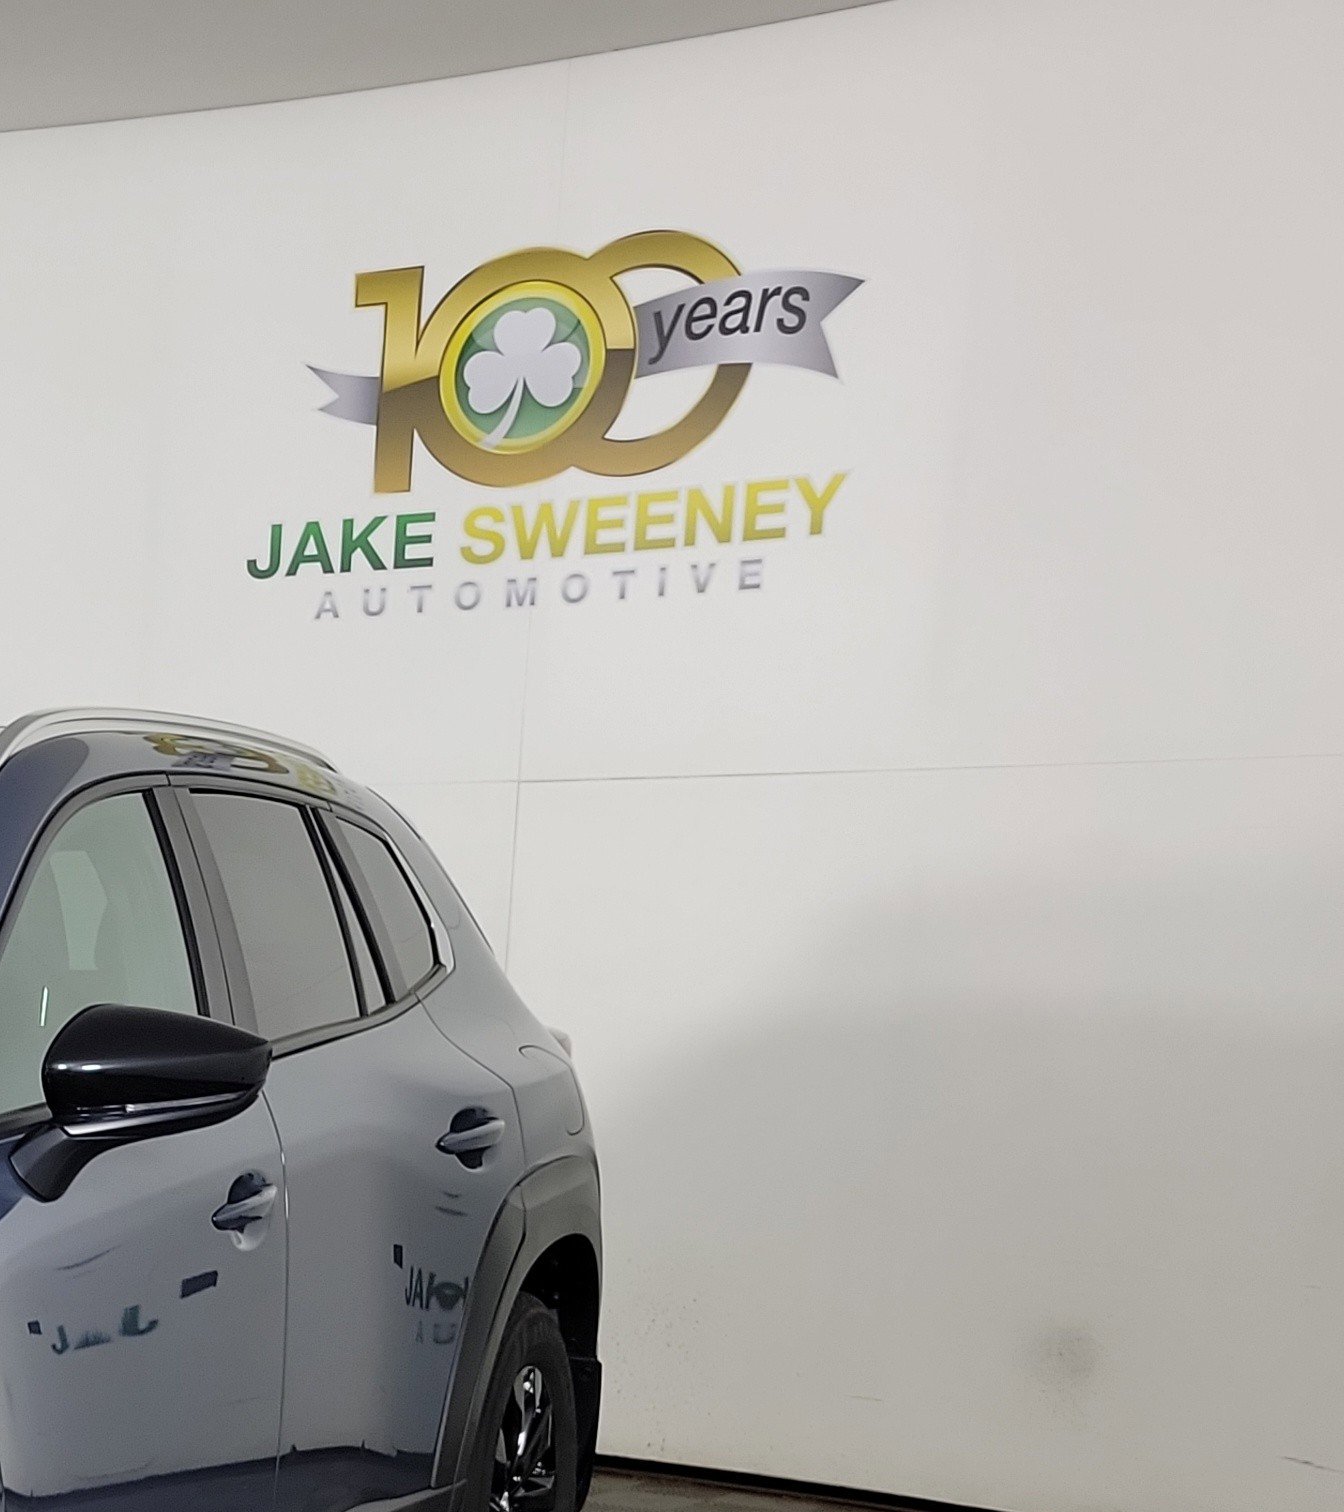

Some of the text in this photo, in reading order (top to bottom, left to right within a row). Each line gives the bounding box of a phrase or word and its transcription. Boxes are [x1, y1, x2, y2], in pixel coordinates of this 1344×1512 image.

[354, 229, 811, 495] 100 years
[245, 472, 850, 580] JAKE SWEENEY
[313, 557, 764, 622] AUTOMOTIVE
